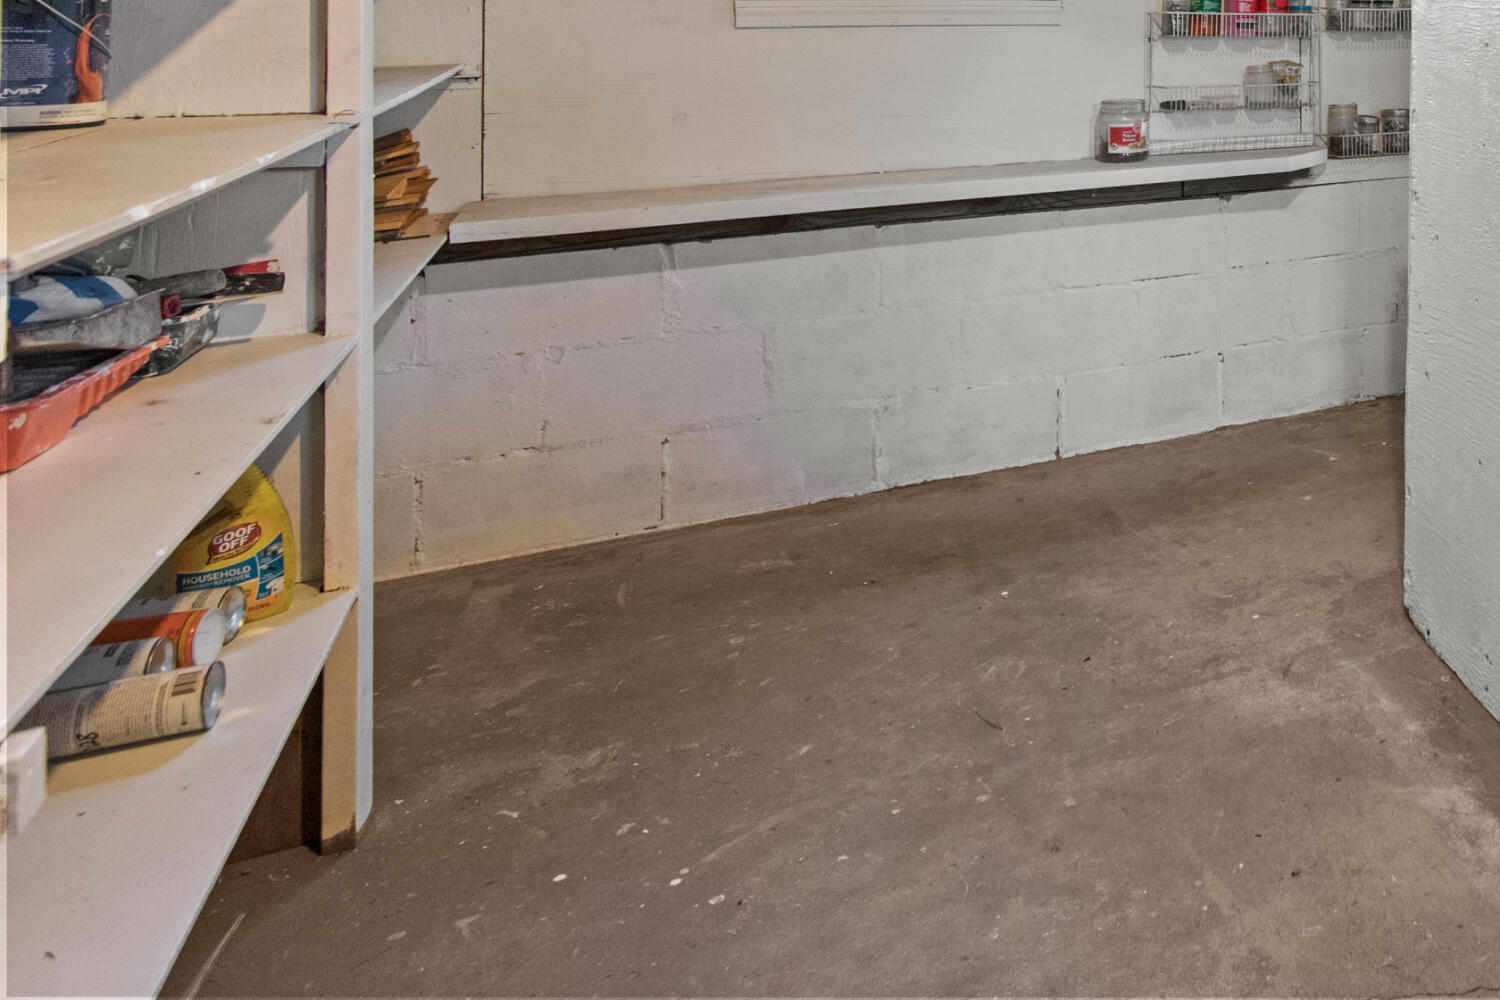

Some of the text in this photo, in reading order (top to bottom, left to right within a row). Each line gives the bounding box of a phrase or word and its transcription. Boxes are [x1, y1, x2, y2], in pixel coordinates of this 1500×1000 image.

[212, 523, 257, 546] GOOF
[218, 535, 249, 553] OFF
[182, 565, 251, 586] HOUSEHOLD
